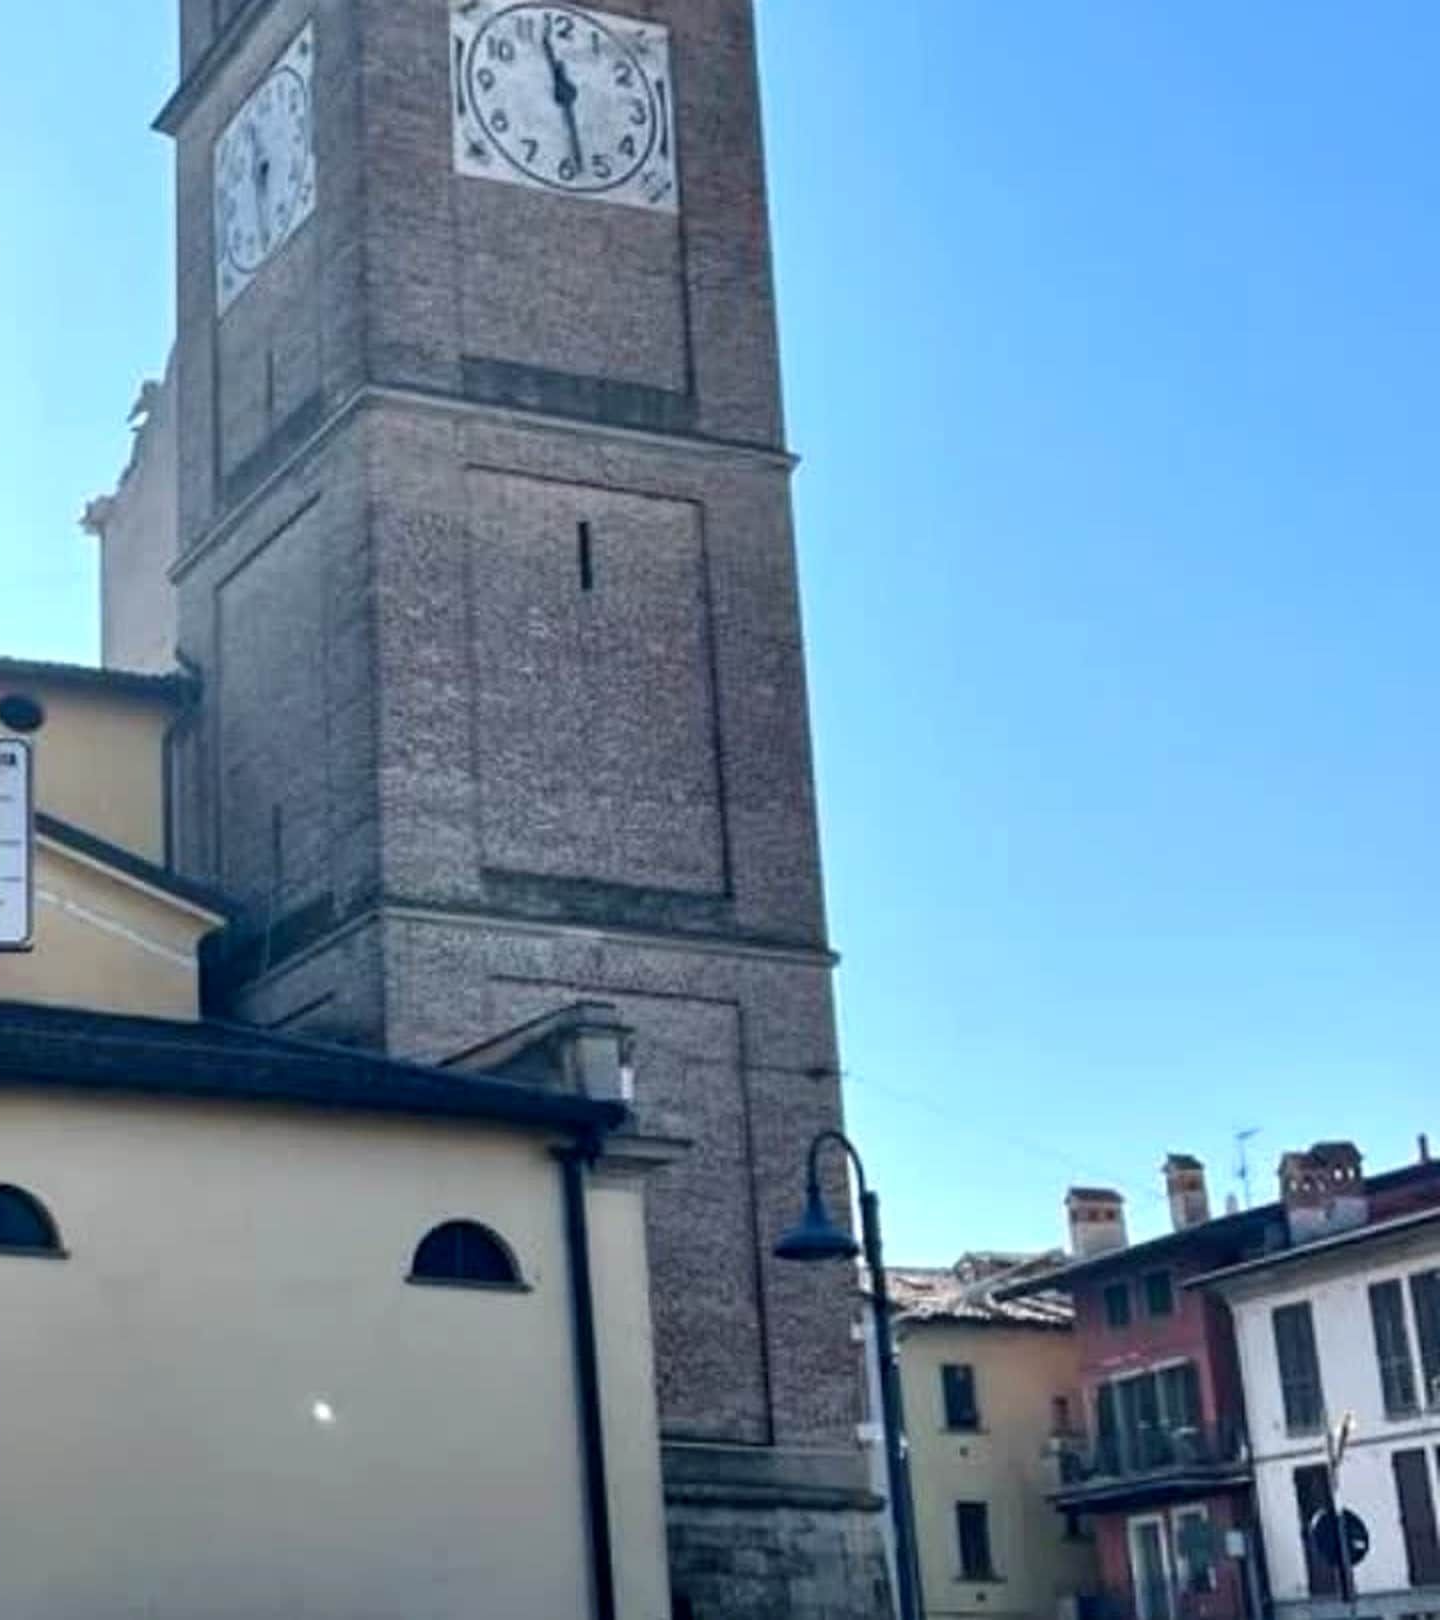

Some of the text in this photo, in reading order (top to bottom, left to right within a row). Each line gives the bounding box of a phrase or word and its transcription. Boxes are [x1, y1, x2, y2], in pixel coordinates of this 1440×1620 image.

[515, 15, 535, 43] 11
[543, 12, 576, 40] 12
[487, 34, 515, 62] 10
[591, 31, 600, 55] 1
[477, 67, 495, 92] 9
[613, 61, 633, 88] 2
[490, 108, 509, 133] 8
[629, 101, 647, 125] 3
[520, 138, 539, 163] 7
[618, 134, 636, 158] 4
[558, 156, 576, 181] 6
[591, 154, 612, 179] 5
